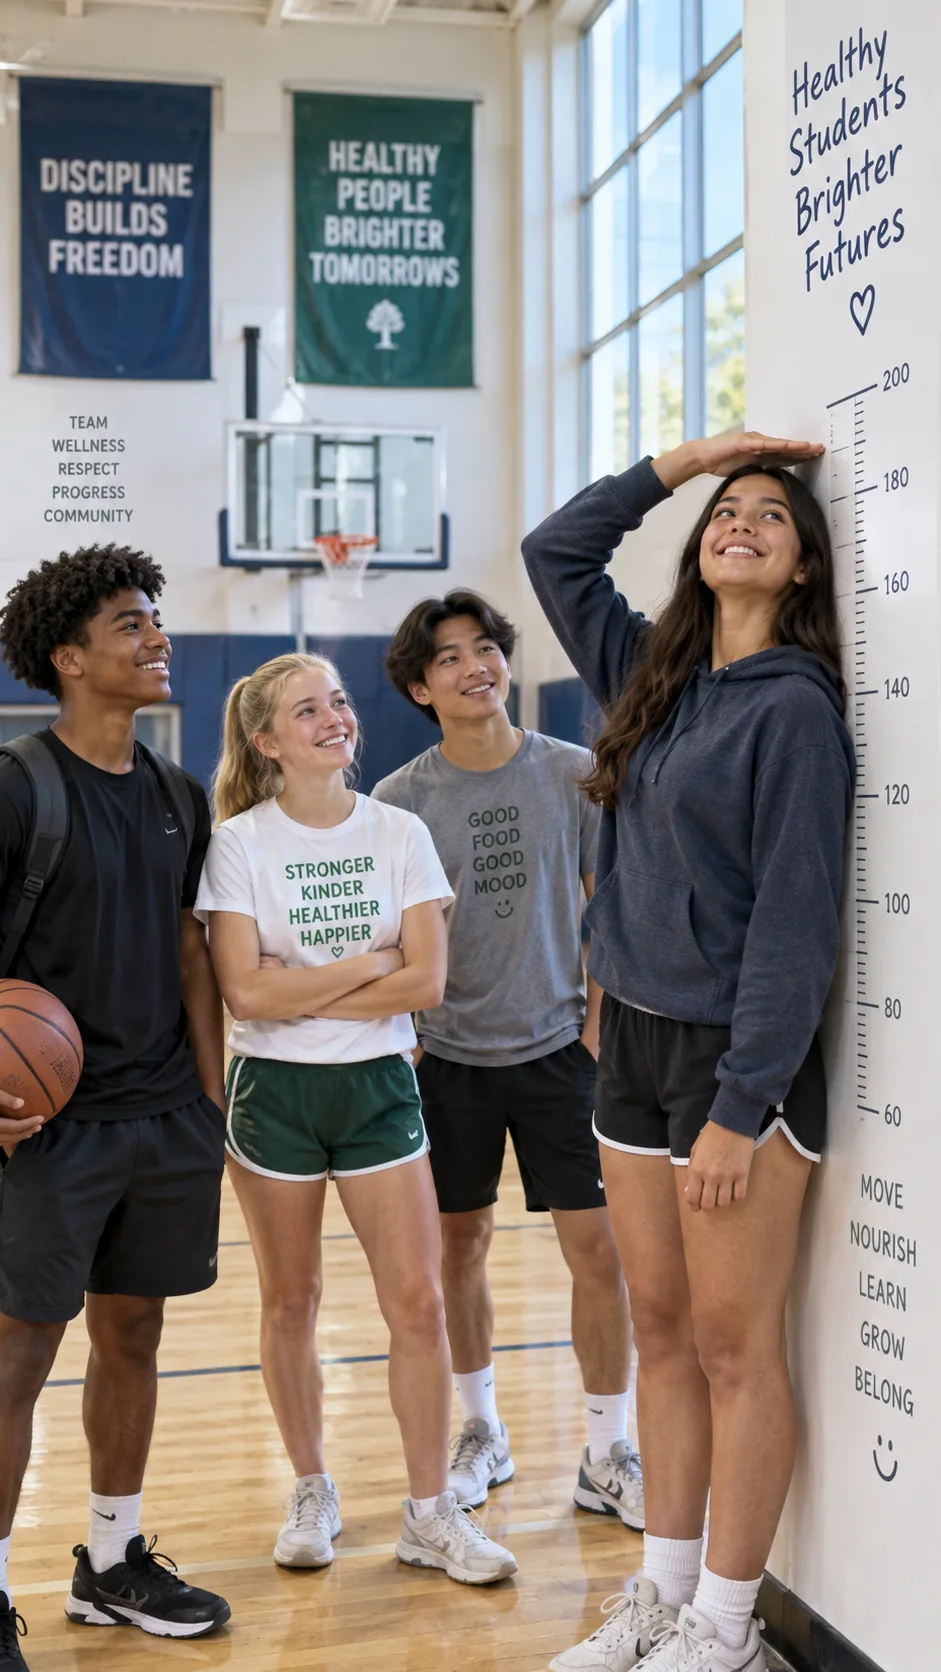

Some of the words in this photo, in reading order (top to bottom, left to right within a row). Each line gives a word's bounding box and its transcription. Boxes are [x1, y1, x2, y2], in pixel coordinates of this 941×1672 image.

[792, 27, 887, 116] Healthy
[789, 73, 906, 176] Students
[329, 141, 441, 176] HEALTHY
[40, 158, 193, 197] DISCIPLINE
[795, 144, 903, 236] Brighter
[337, 178, 432, 214] PEOPLE
[65, 201, 168, 237] BUILDS
[324, 215, 445, 252] BRIGHTER
[48, 240, 184, 278] FREEDOM
[805, 207, 905, 292] Futures
[309, 252, 460, 288] TOMORROWS
[882, 362, 910, 392] 200
[69, 416, 108, 429] TEAM
[52, 439, 126, 452] WELLNESS
[58, 462, 120, 475] RESPECT
[884, 466, 909, 492] 180
[52, 486, 126, 499] PROGRESS
[44, 509, 133, 522] COMMUNITY
[884, 570, 910, 596] 160
[884, 676, 910, 700] 140
[884, 783, 910, 805] 120
[468, 805, 520, 828] GOOD
[472, 828, 520, 850] FOOD
[285, 856, 375, 881] STRONGER
[473, 850, 524, 873] GOOD
[301, 879, 364, 901] KINDER
[474, 872, 527, 896] MOOD
[289, 900, 380, 925] HEALTHIER
[884, 892, 911, 915] 100
[300, 923, 372, 947] HAPPIER
[884, 997, 902, 1020] 80
[884, 1103, 902, 1127] 60
[860, 1173, 903, 1210] MOVE
[850, 1220, 917, 1267] NOURISH
[859, 1271, 907, 1312] LEARN
[860, 1320, 905, 1361] GROW
[855, 1365, 914, 1417] BELONG
